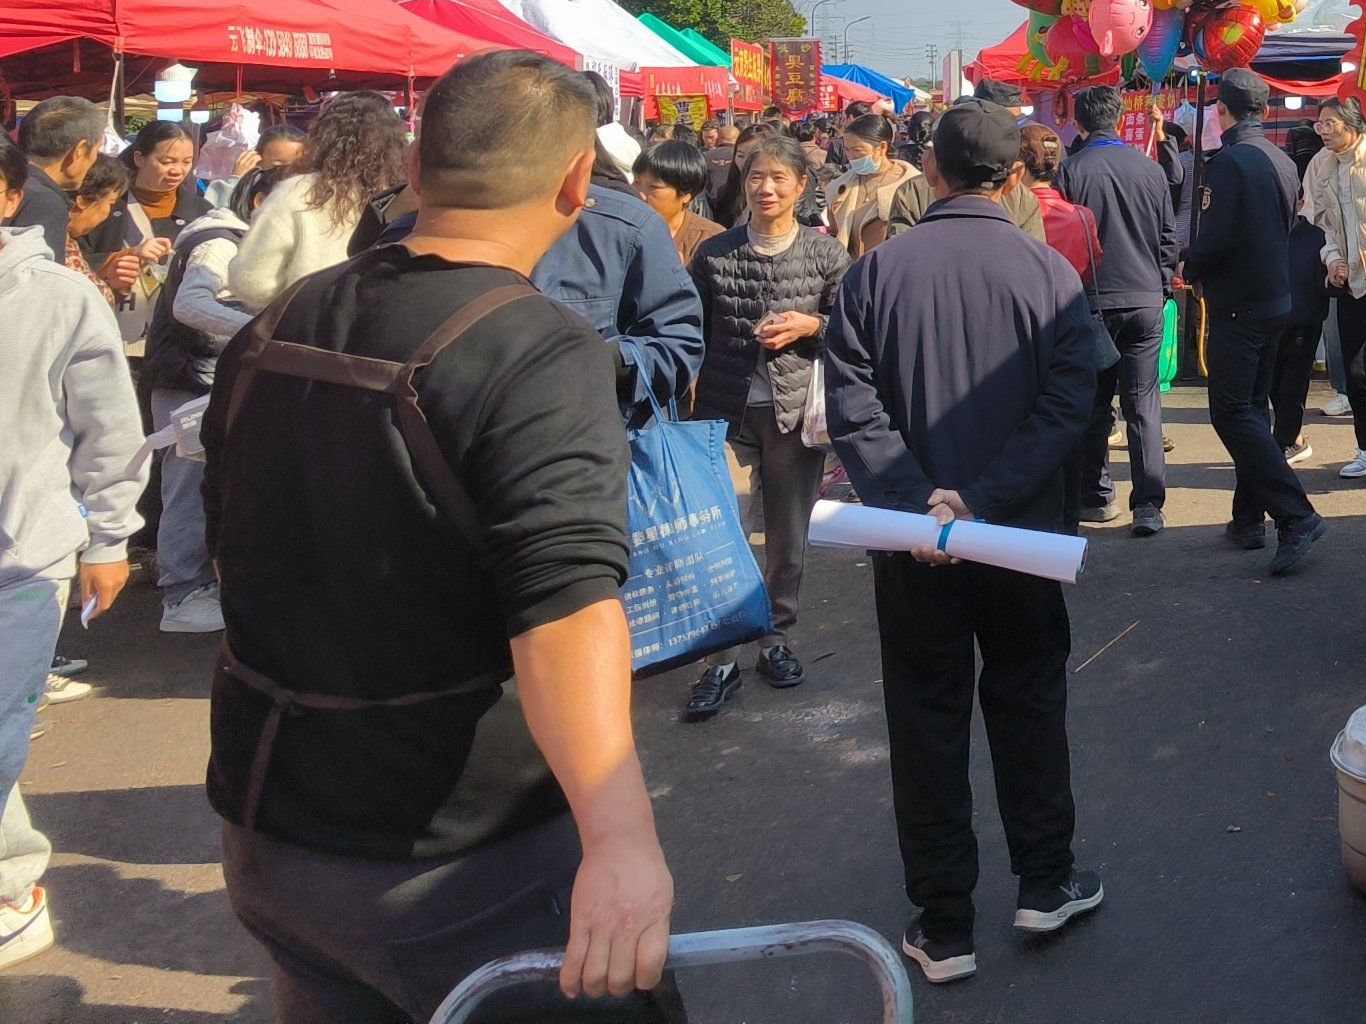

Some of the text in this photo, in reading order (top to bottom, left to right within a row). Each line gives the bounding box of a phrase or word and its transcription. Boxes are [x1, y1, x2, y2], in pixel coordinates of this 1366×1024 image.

[784, 54, 805, 105] 臭豆腐
[1126, 112, 1146, 125] 面条
[1125, 127, 1146, 141] 喜蛋
